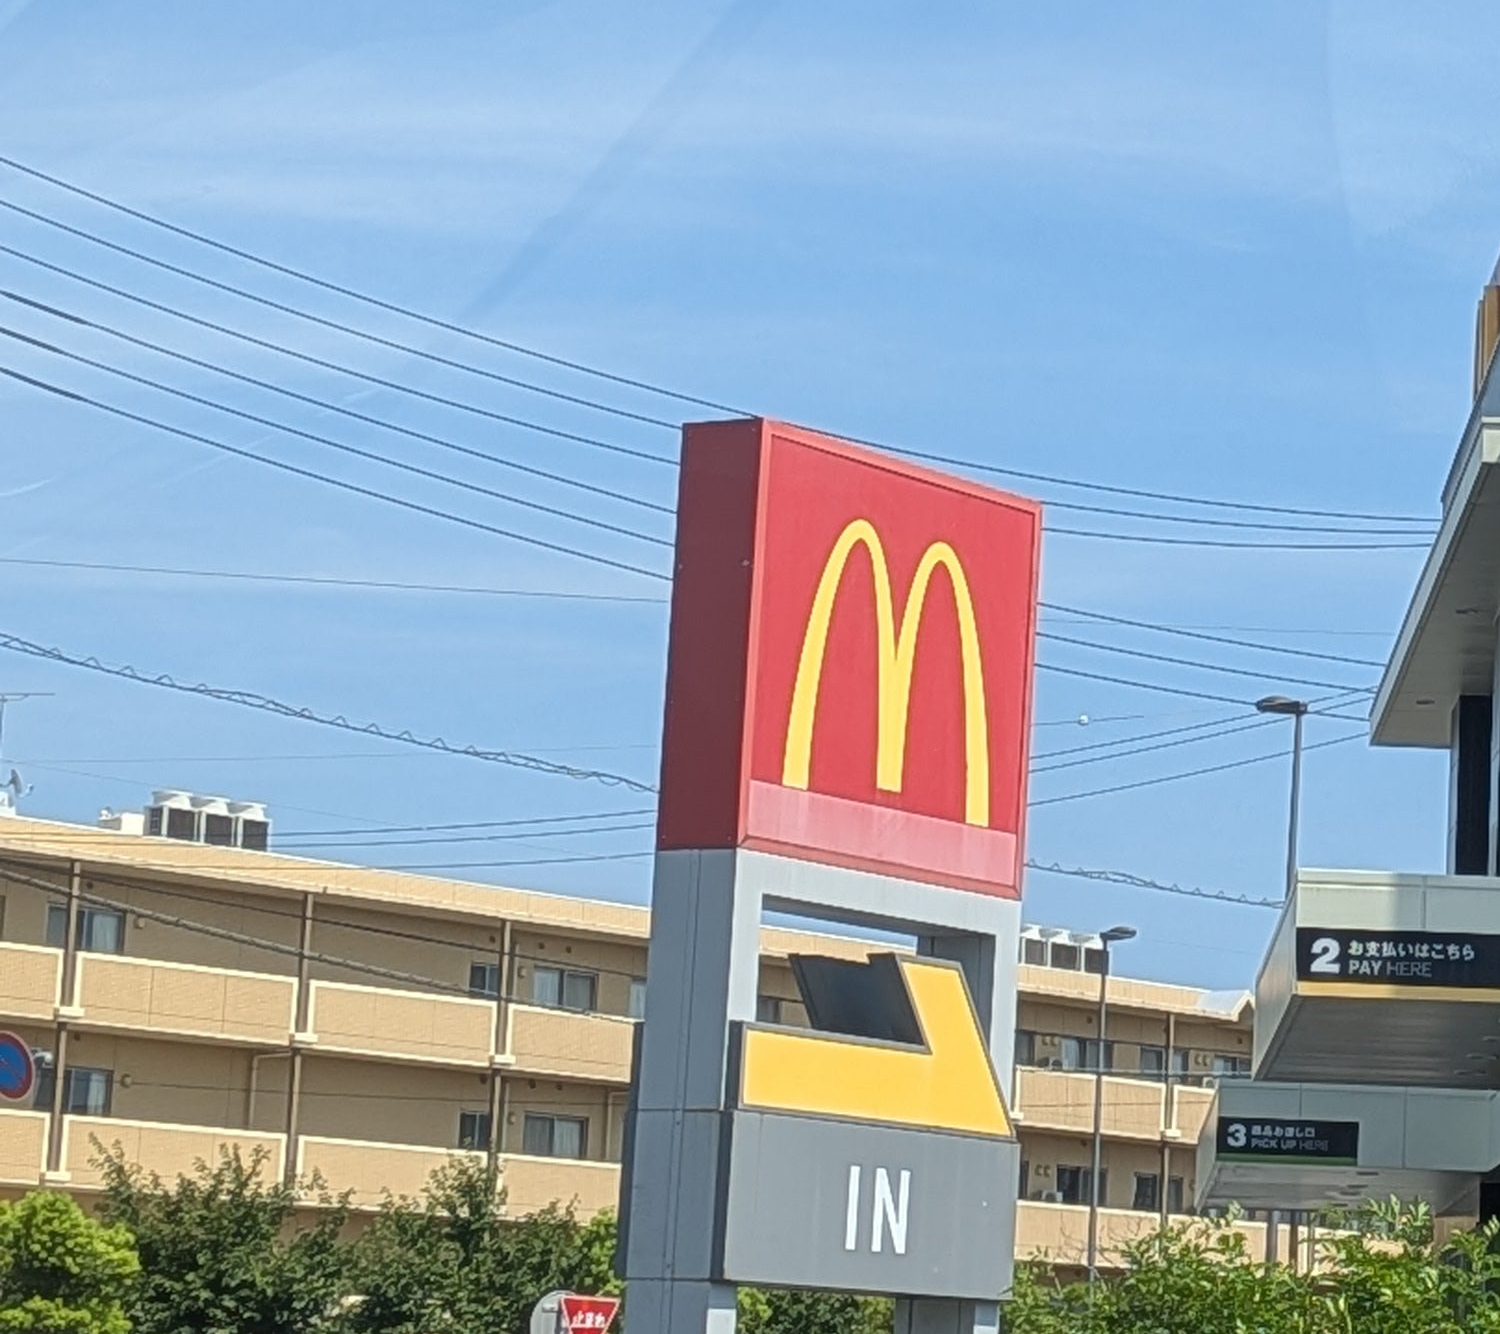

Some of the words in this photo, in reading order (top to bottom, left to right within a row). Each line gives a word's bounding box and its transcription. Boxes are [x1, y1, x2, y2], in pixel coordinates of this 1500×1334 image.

[1309, 936, 1342, 975] 2
[1347, 939, 1476, 962] お支払いはこちら
[1347, 959, 1384, 976] PAY
[1386, 961, 1433, 978] HERE
[1226, 1123, 1248, 1147] 3
[845, 1165, 911, 1254] IN
